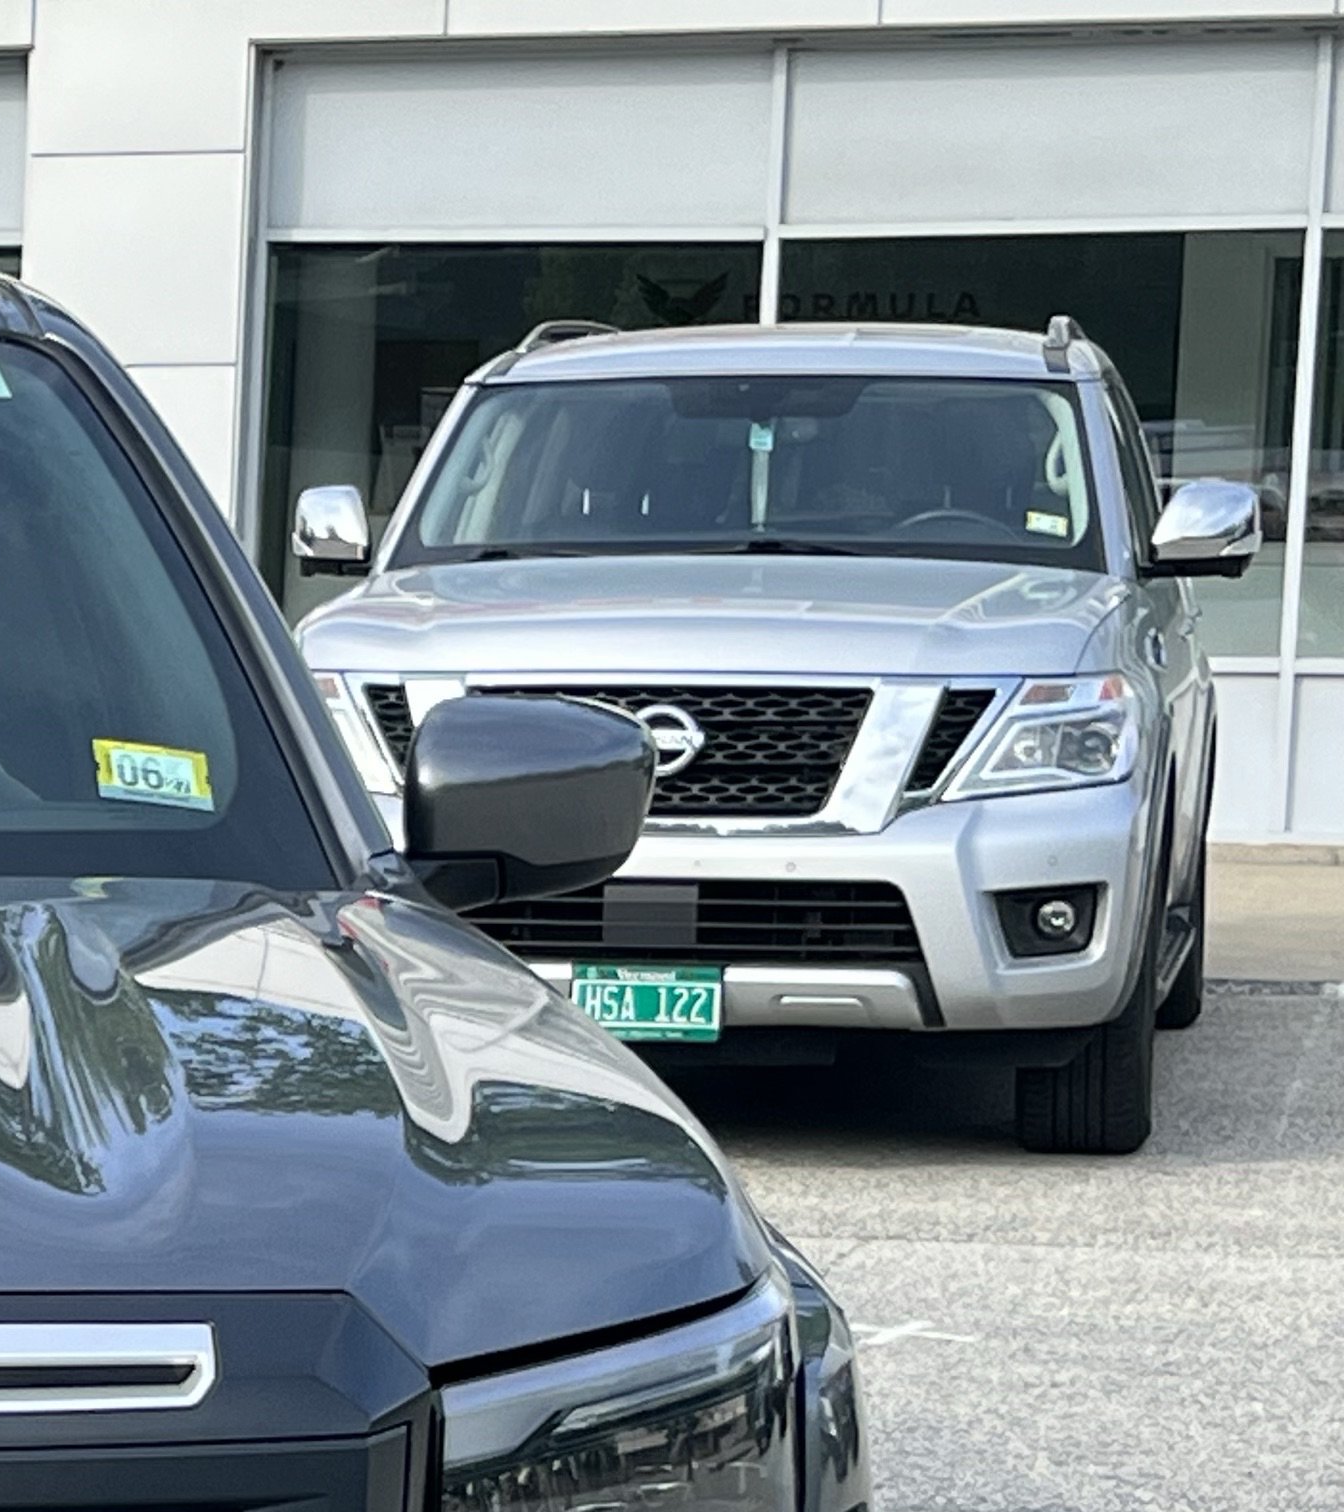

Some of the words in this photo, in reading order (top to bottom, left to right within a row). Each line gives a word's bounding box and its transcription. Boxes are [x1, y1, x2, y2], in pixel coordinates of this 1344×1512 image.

[742, 291, 981, 320] FORMULA
[117, 754, 164, 790] 06
[584, 985, 636, 1021] HSA
[654, 986, 708, 1024] 122
